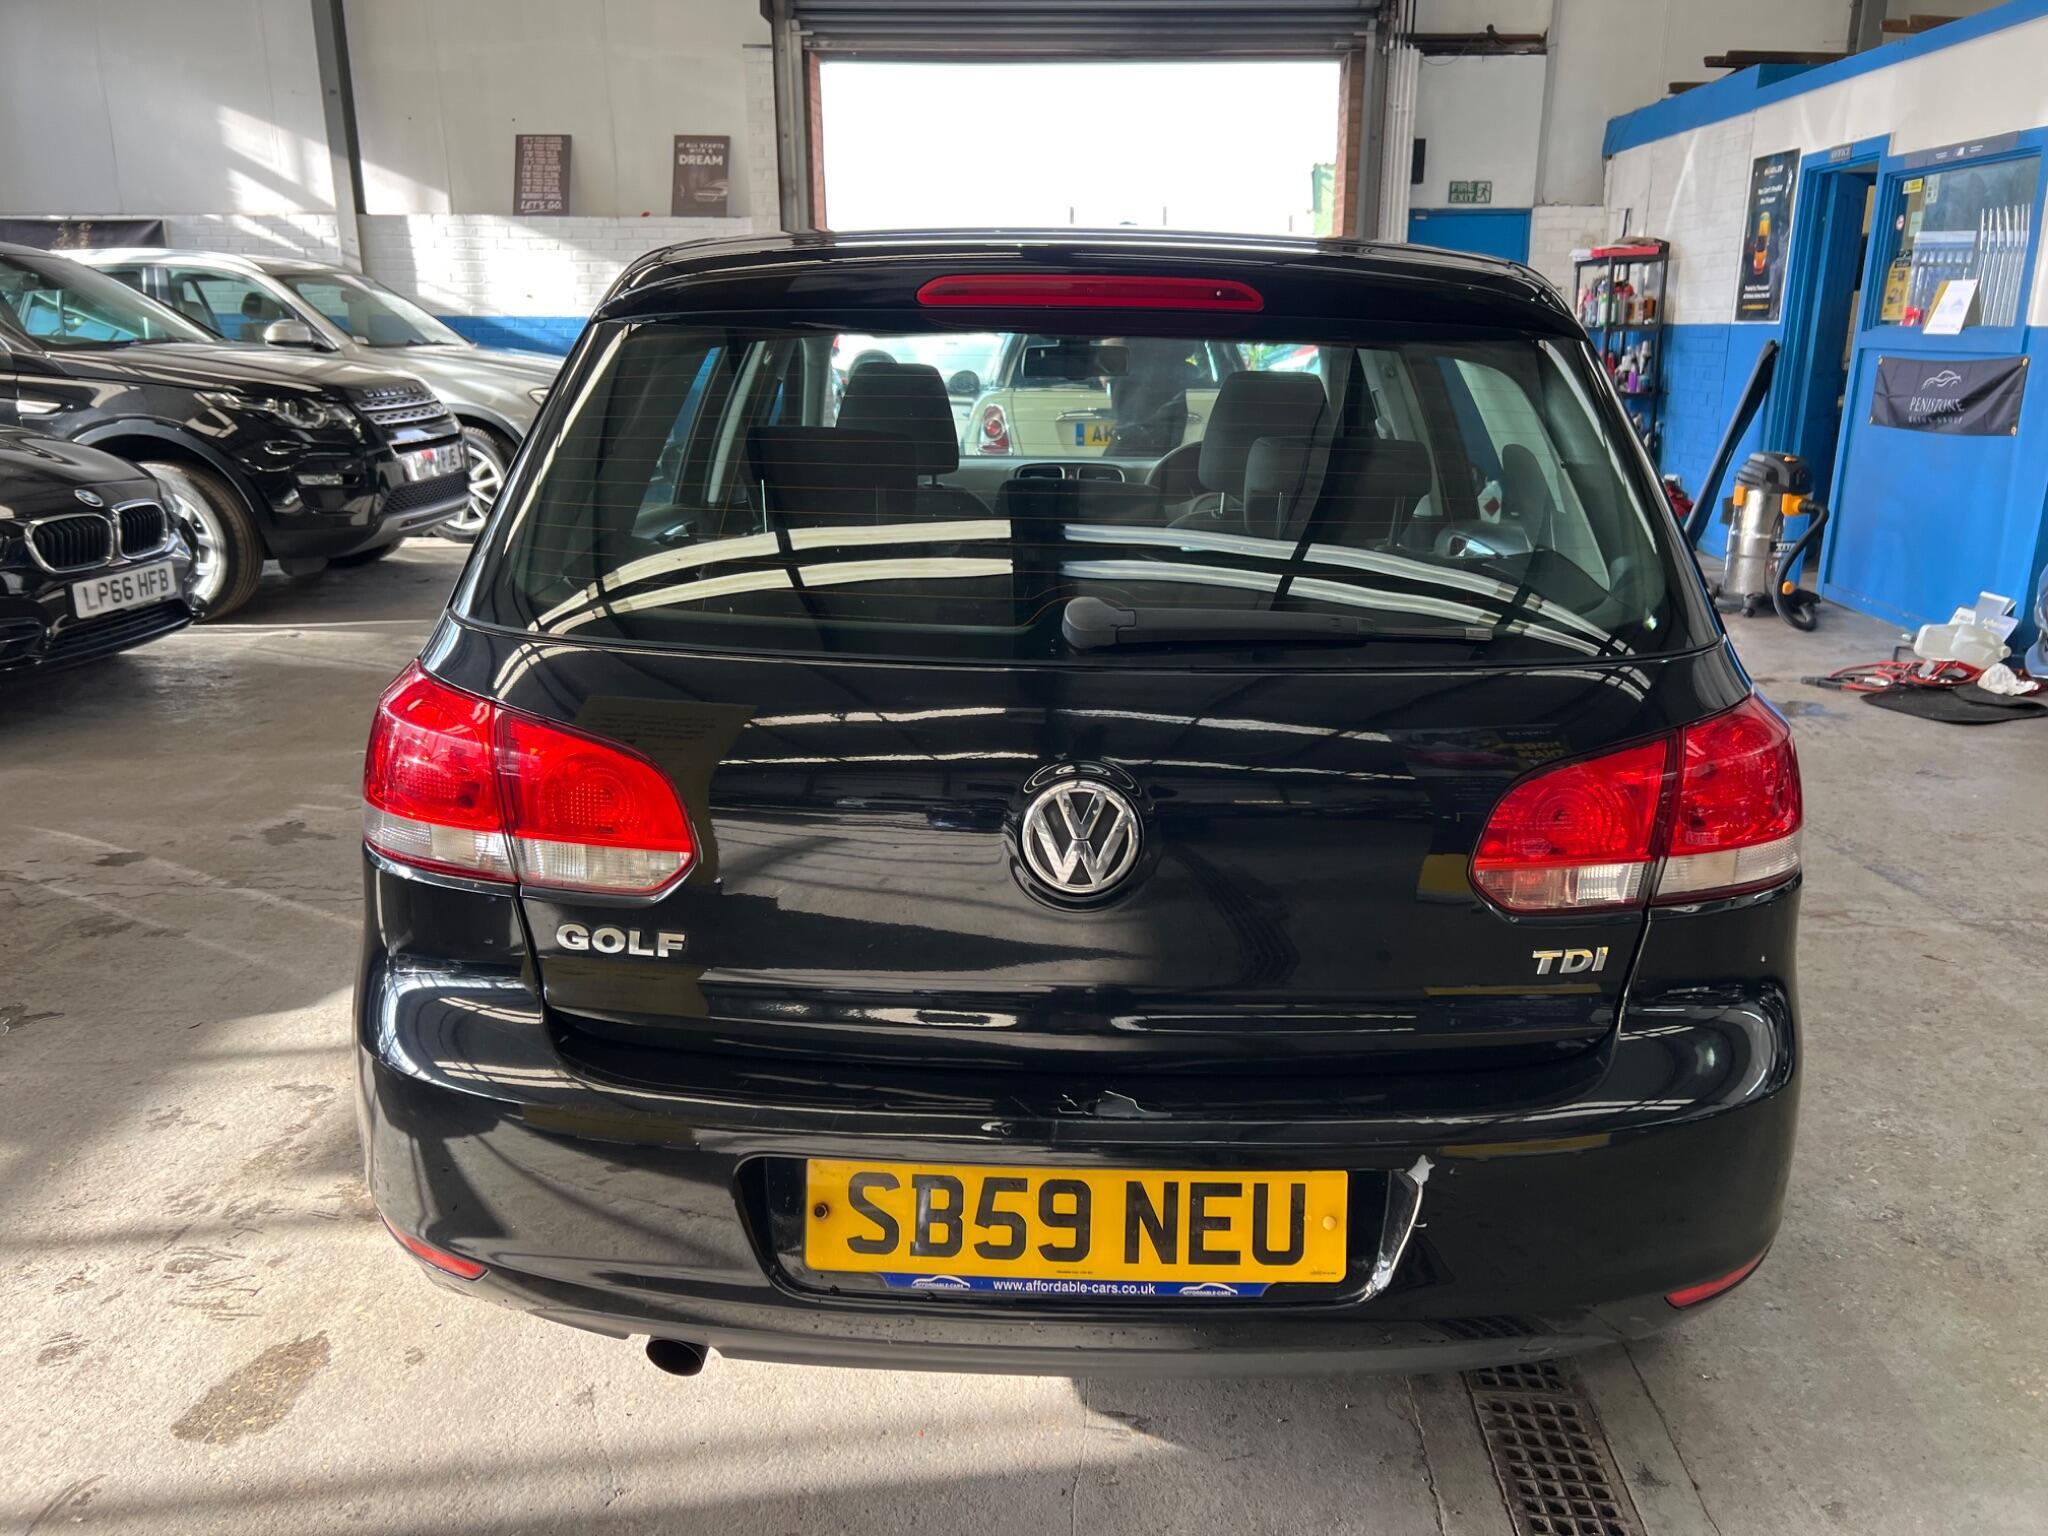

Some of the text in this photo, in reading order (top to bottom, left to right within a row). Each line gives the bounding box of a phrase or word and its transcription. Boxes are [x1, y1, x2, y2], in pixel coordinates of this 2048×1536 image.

[679, 154, 723, 166] DREAM
[1451, 182, 1474, 192] FIRE
[520, 200, 546, 210] LET'S
[1451, 192, 1474, 202] EXIT
[1909, 396, 1966, 413] PENISTONE
[83, 568, 169, 611] LP66 HFB
[556, 923, 686, 957] GOLF
[1532, 946, 1609, 975] TDI
[847, 1171, 1307, 1266] SB59 NEU
[993, 1279, 1156, 1295] www.affordable-cars.co.uk
